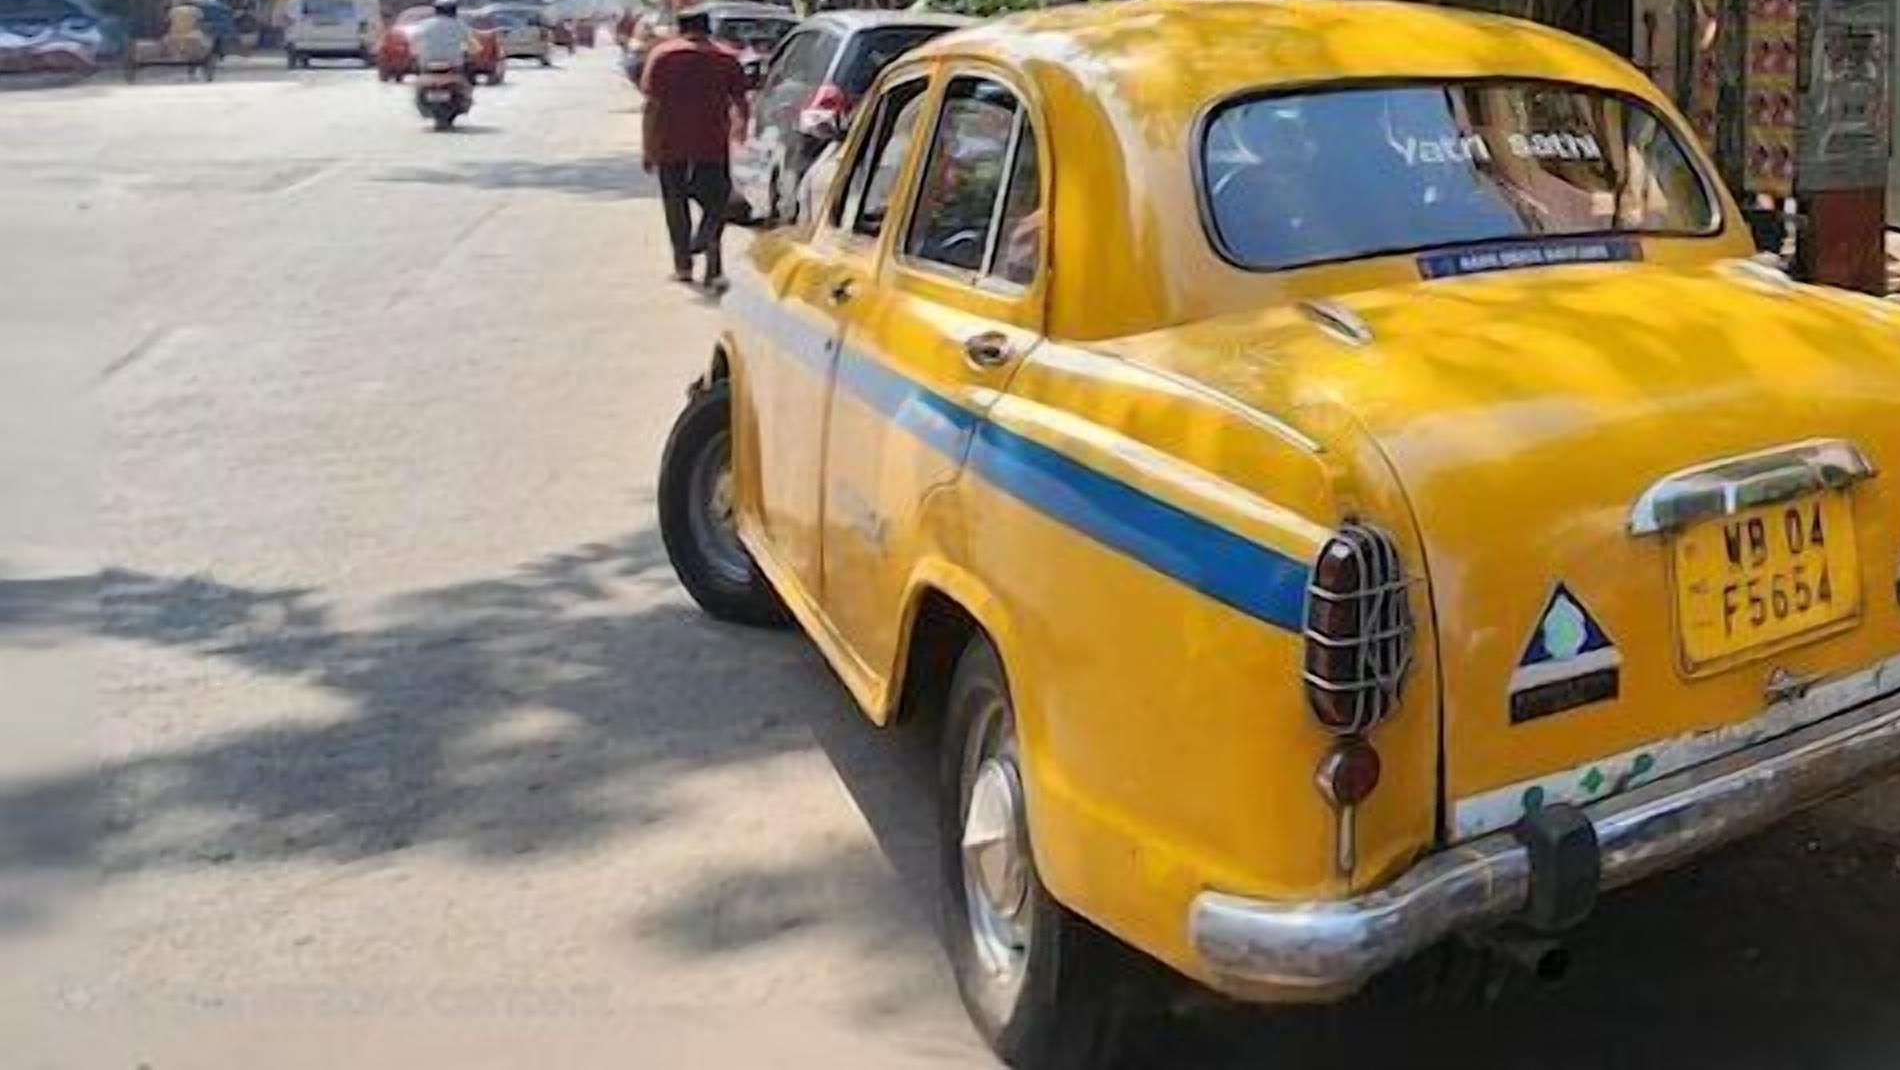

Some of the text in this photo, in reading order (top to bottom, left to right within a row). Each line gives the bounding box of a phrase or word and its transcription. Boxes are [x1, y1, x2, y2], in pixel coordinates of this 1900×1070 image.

[1723, 499, 1825, 572] WB 04
[1723, 558, 1833, 637] F5654
